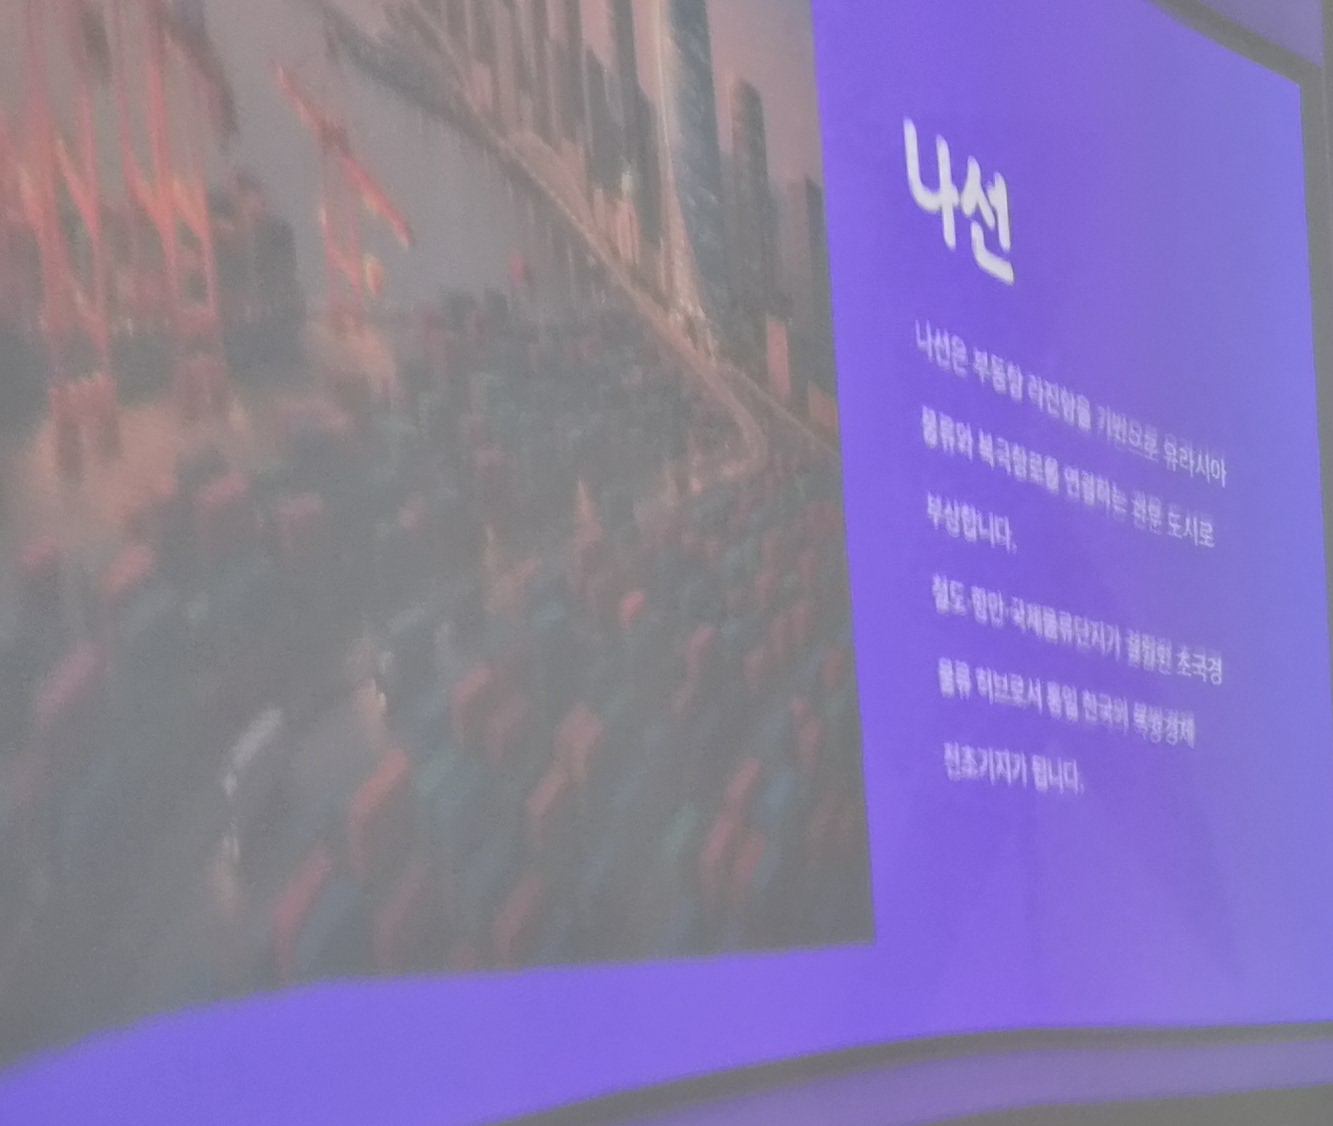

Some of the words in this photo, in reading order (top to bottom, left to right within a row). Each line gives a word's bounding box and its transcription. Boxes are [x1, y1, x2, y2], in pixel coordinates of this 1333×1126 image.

[904, 117, 1014, 284] 나선
[915, 319, 967, 378] 나선은
[1163, 433, 1227, 488] 유라시아
[1166, 504, 1215, 548] 도시로
[1176, 645, 1223, 685] 초국경
